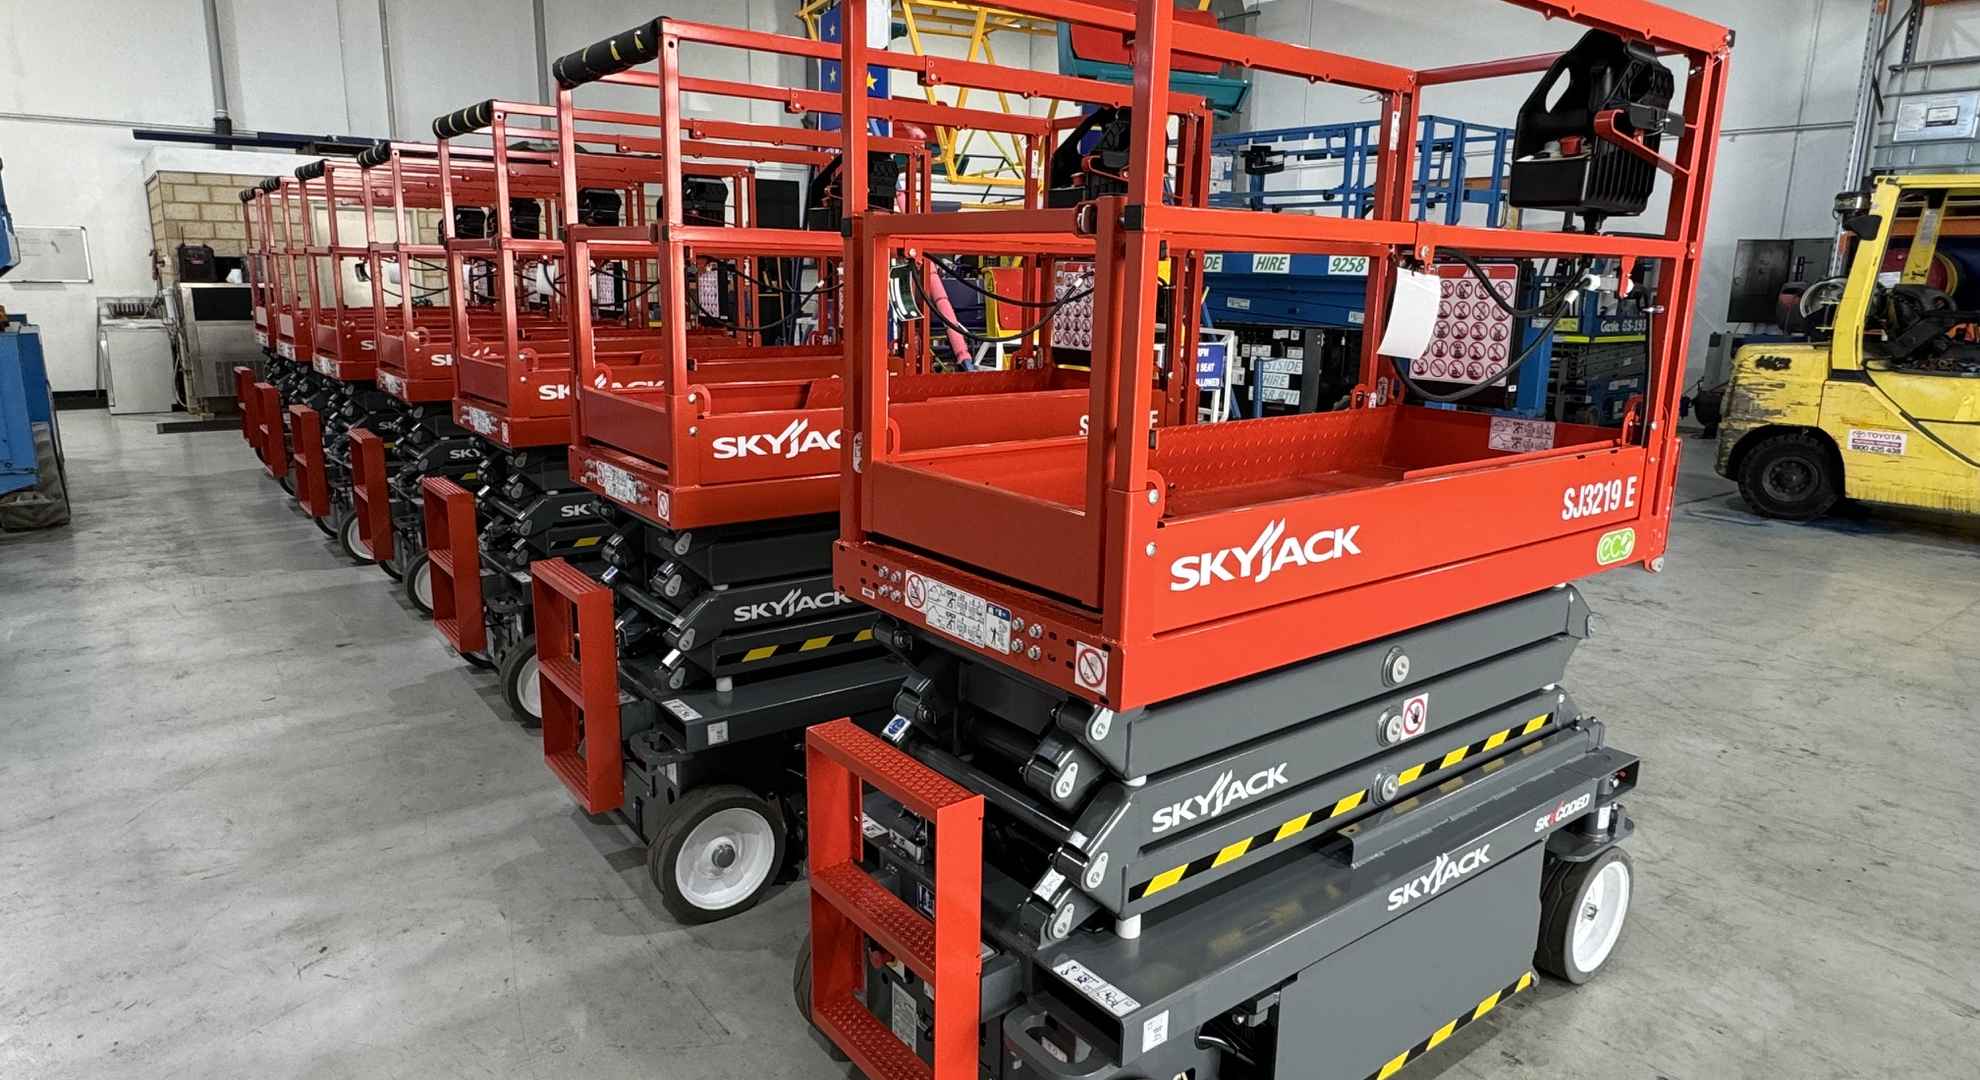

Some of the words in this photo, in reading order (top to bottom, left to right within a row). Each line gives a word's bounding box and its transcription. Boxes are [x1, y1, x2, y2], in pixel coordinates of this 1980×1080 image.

[1255, 256, 1287, 271] HIRE
[1330, 257, 1366, 272] 9258
[1867, 431, 1902, 440] TOYOTA
[1562, 479, 1622, 520] SJ3219
[1624, 476, 1638, 508] E
[1170, 517, 1361, 592] SKYJACK
[733, 587, 853, 622] SKYJACK
[1152, 762, 1289, 833] SKYJACK
[1387, 843, 1491, 911] SKYJACK
